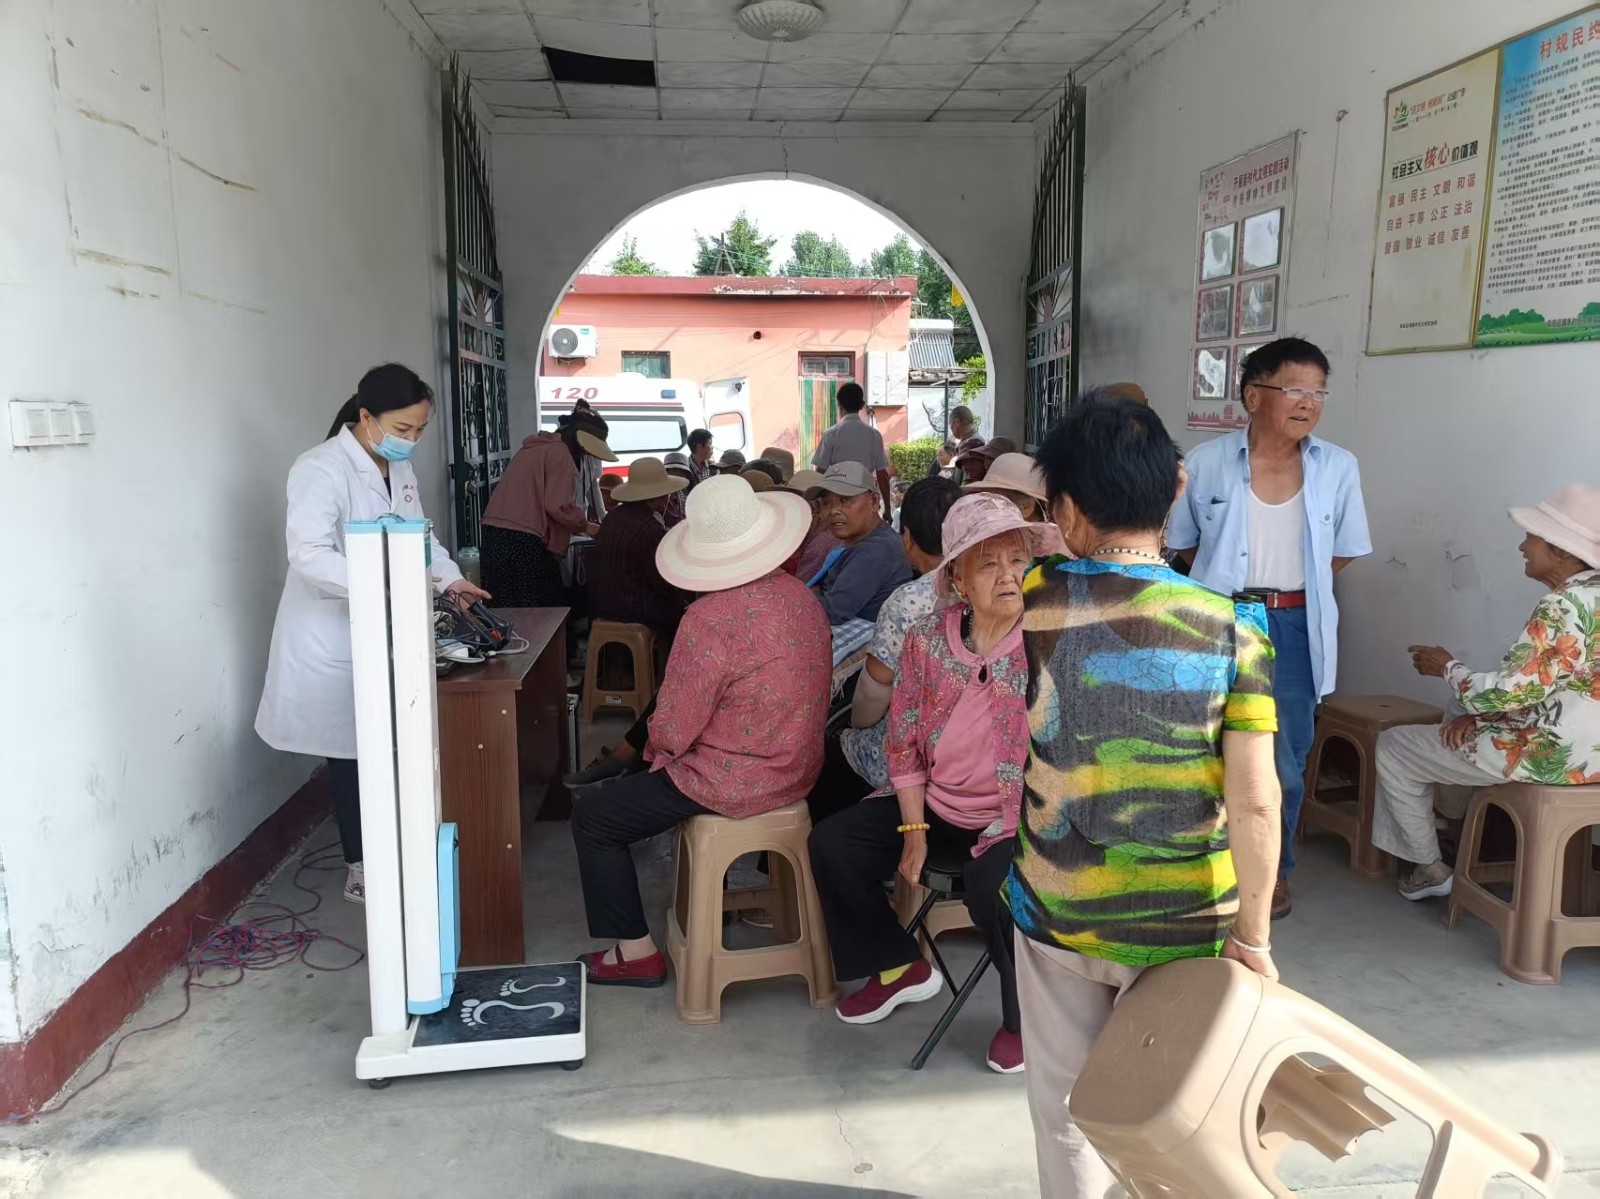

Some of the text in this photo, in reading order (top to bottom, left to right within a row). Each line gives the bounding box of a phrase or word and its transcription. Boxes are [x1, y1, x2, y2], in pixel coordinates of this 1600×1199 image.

[1392, 140, 1478, 180] 社会主义核心价值观
[1389, 192, 1405, 209] 富强
[1410, 186, 1427, 202] 民主
[1433, 179, 1451, 197] 文明
[1457, 172, 1476, 190] 和谐
[1387, 199, 1473, 232] 自由 平等 公正 法治
[1384, 239, 1401, 255] 爱国
[1405, 236, 1423, 250] 敬业
[1427, 230, 1445, 246] 诚信
[1451, 224, 1470, 241] 友善
[551, 387, 598, 400] 120
